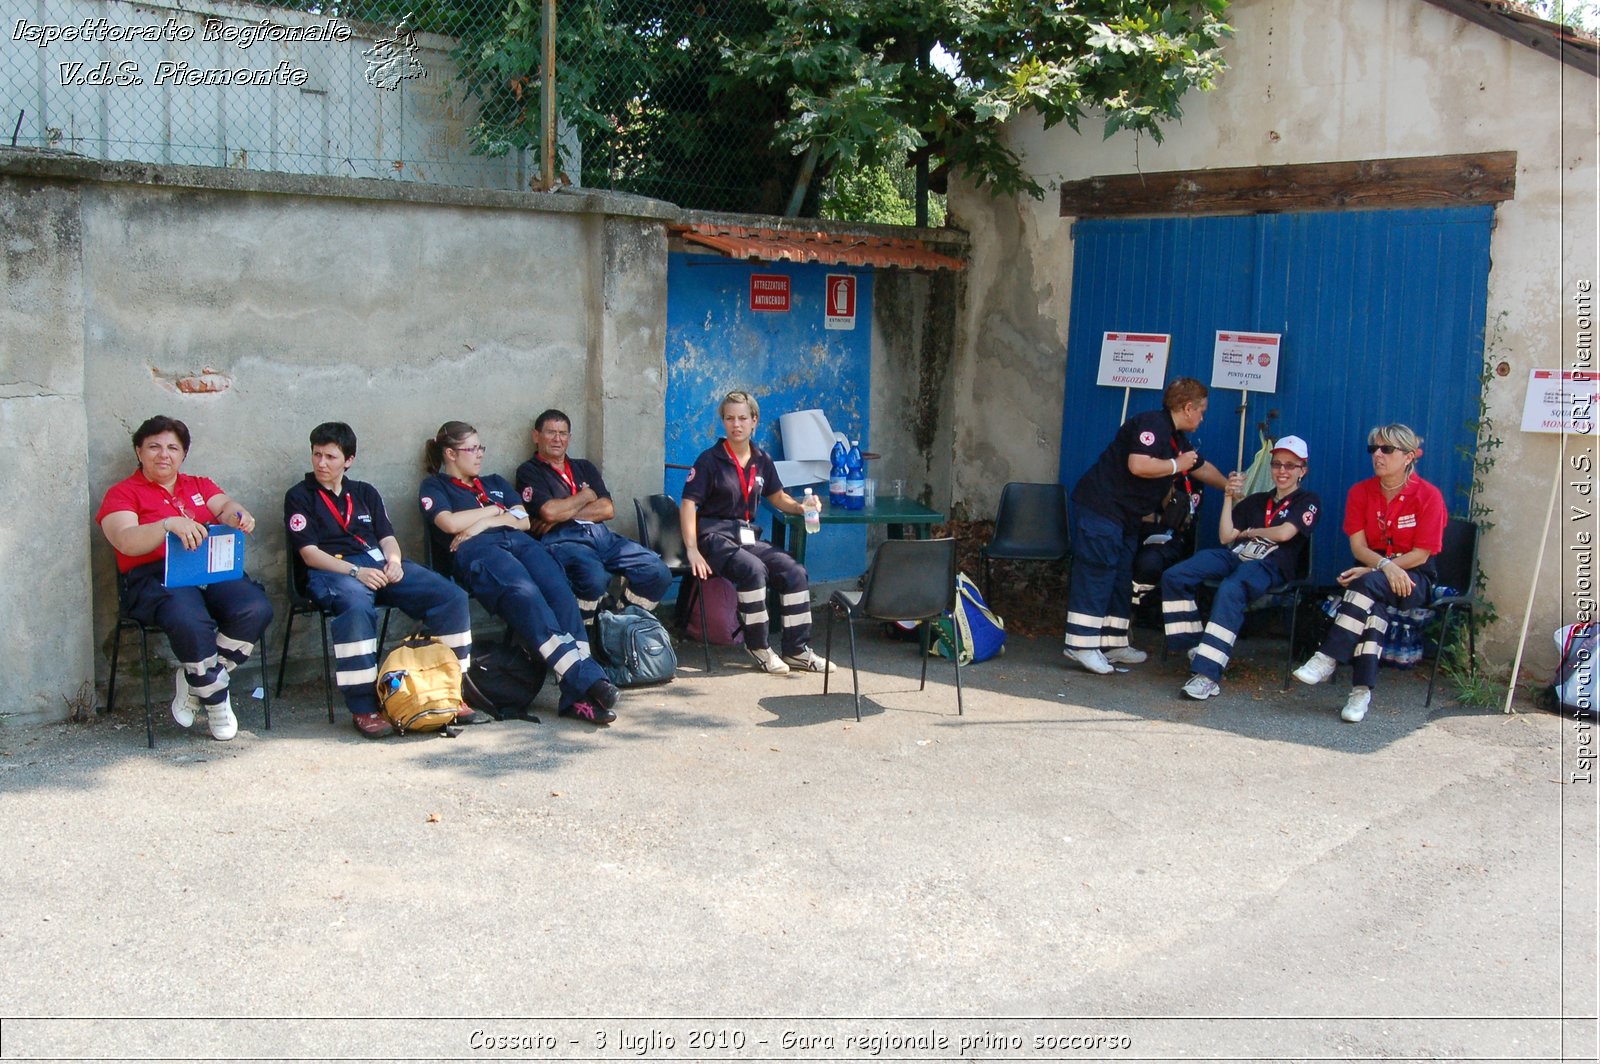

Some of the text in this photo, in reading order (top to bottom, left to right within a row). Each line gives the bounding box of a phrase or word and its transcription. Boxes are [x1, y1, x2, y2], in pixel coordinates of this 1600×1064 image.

[753, 280, 787, 291] ATTREZZATURE
[755, 295, 786, 305] ANTINCENDIO
[1118, 366, 1145, 374] SQUADRA
[1112, 375, 1149, 385] MERGOZZO
[1244, 372, 1262, 380] ATTESA
